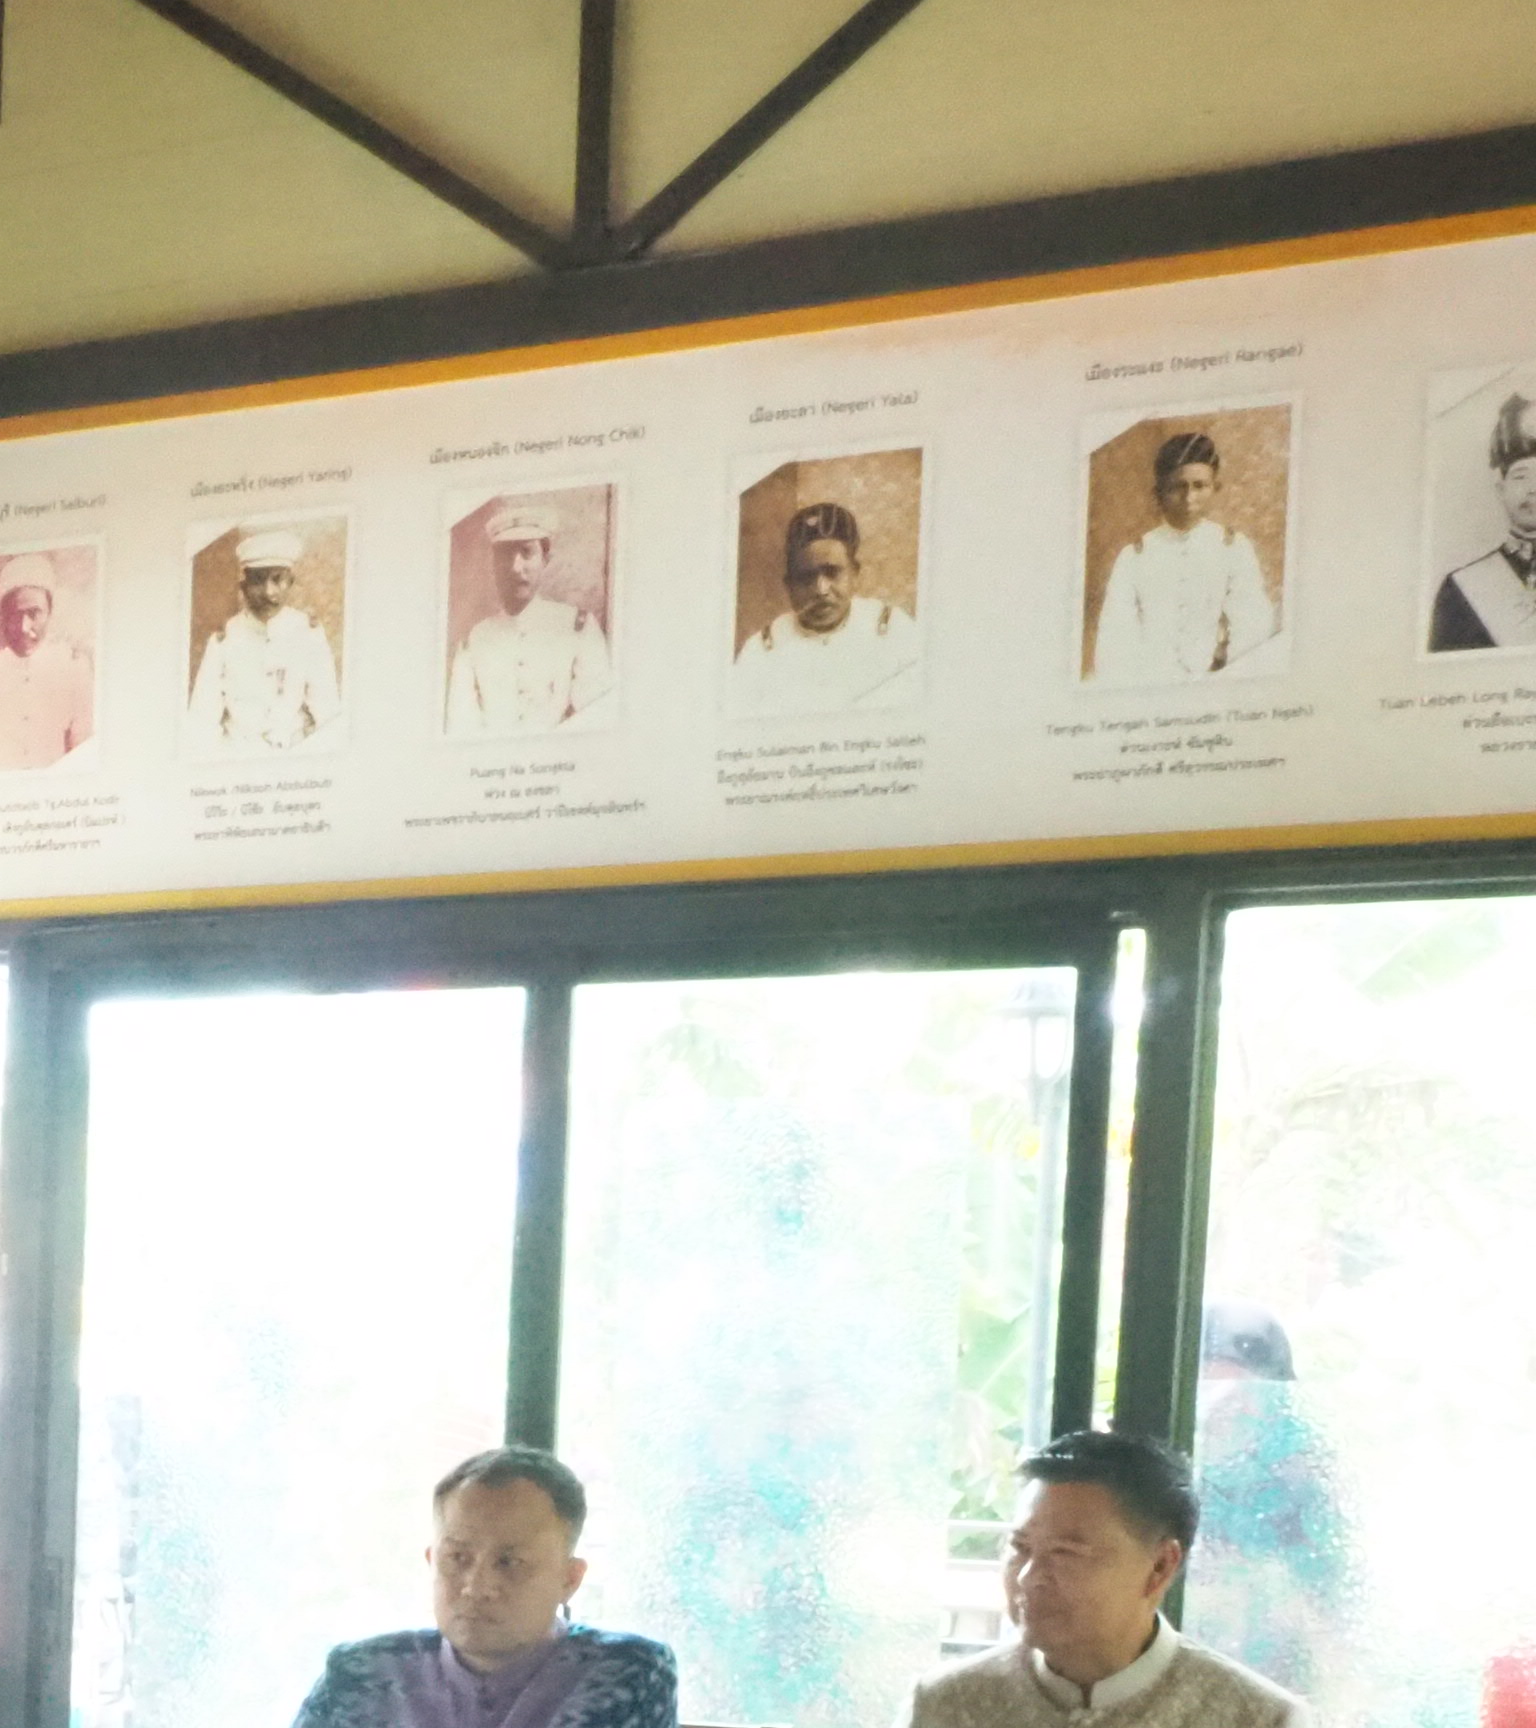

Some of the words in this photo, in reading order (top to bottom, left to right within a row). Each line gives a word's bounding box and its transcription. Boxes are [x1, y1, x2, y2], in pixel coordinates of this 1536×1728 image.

[1170, 350, 1229, 372] (Negeri
[822, 398, 875, 416] (Negeri
[881, 390, 918, 407] Yala)
[514, 437, 563, 455] (Negeri
[568, 434, 605, 447] Nong
[258, 472, 304, 489] (Negeri
[14, 499, 56, 517] (Negeri
[1473, 691, 1508, 704] Long
